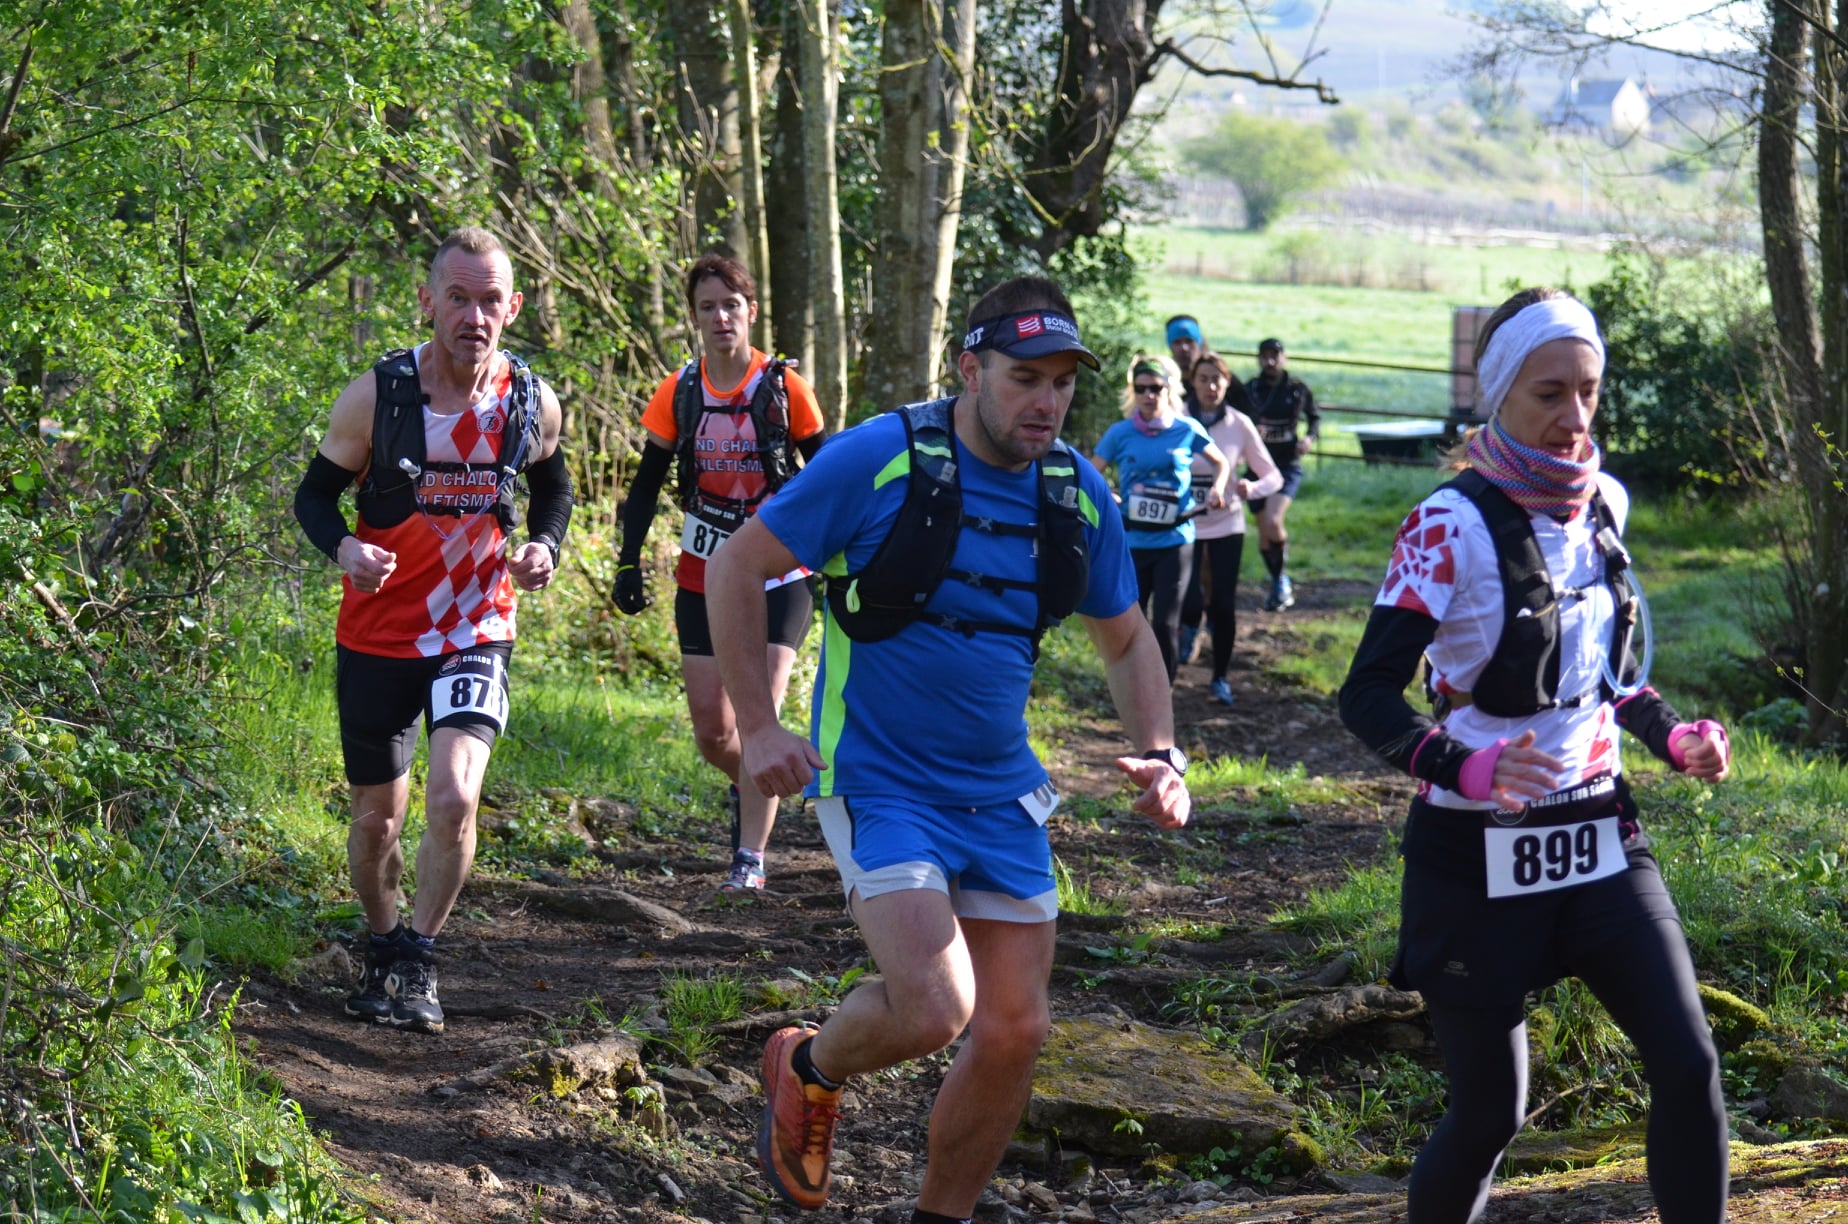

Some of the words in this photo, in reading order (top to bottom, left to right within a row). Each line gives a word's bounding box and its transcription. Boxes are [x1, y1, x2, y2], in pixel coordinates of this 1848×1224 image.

[419, 472, 436, 487] D
[1137, 502, 1169, 520] 897
[1530, 792, 1569, 808] CHALON
[1571, 786, 1588, 801] SUR
[1512, 822, 1599, 887] 899
